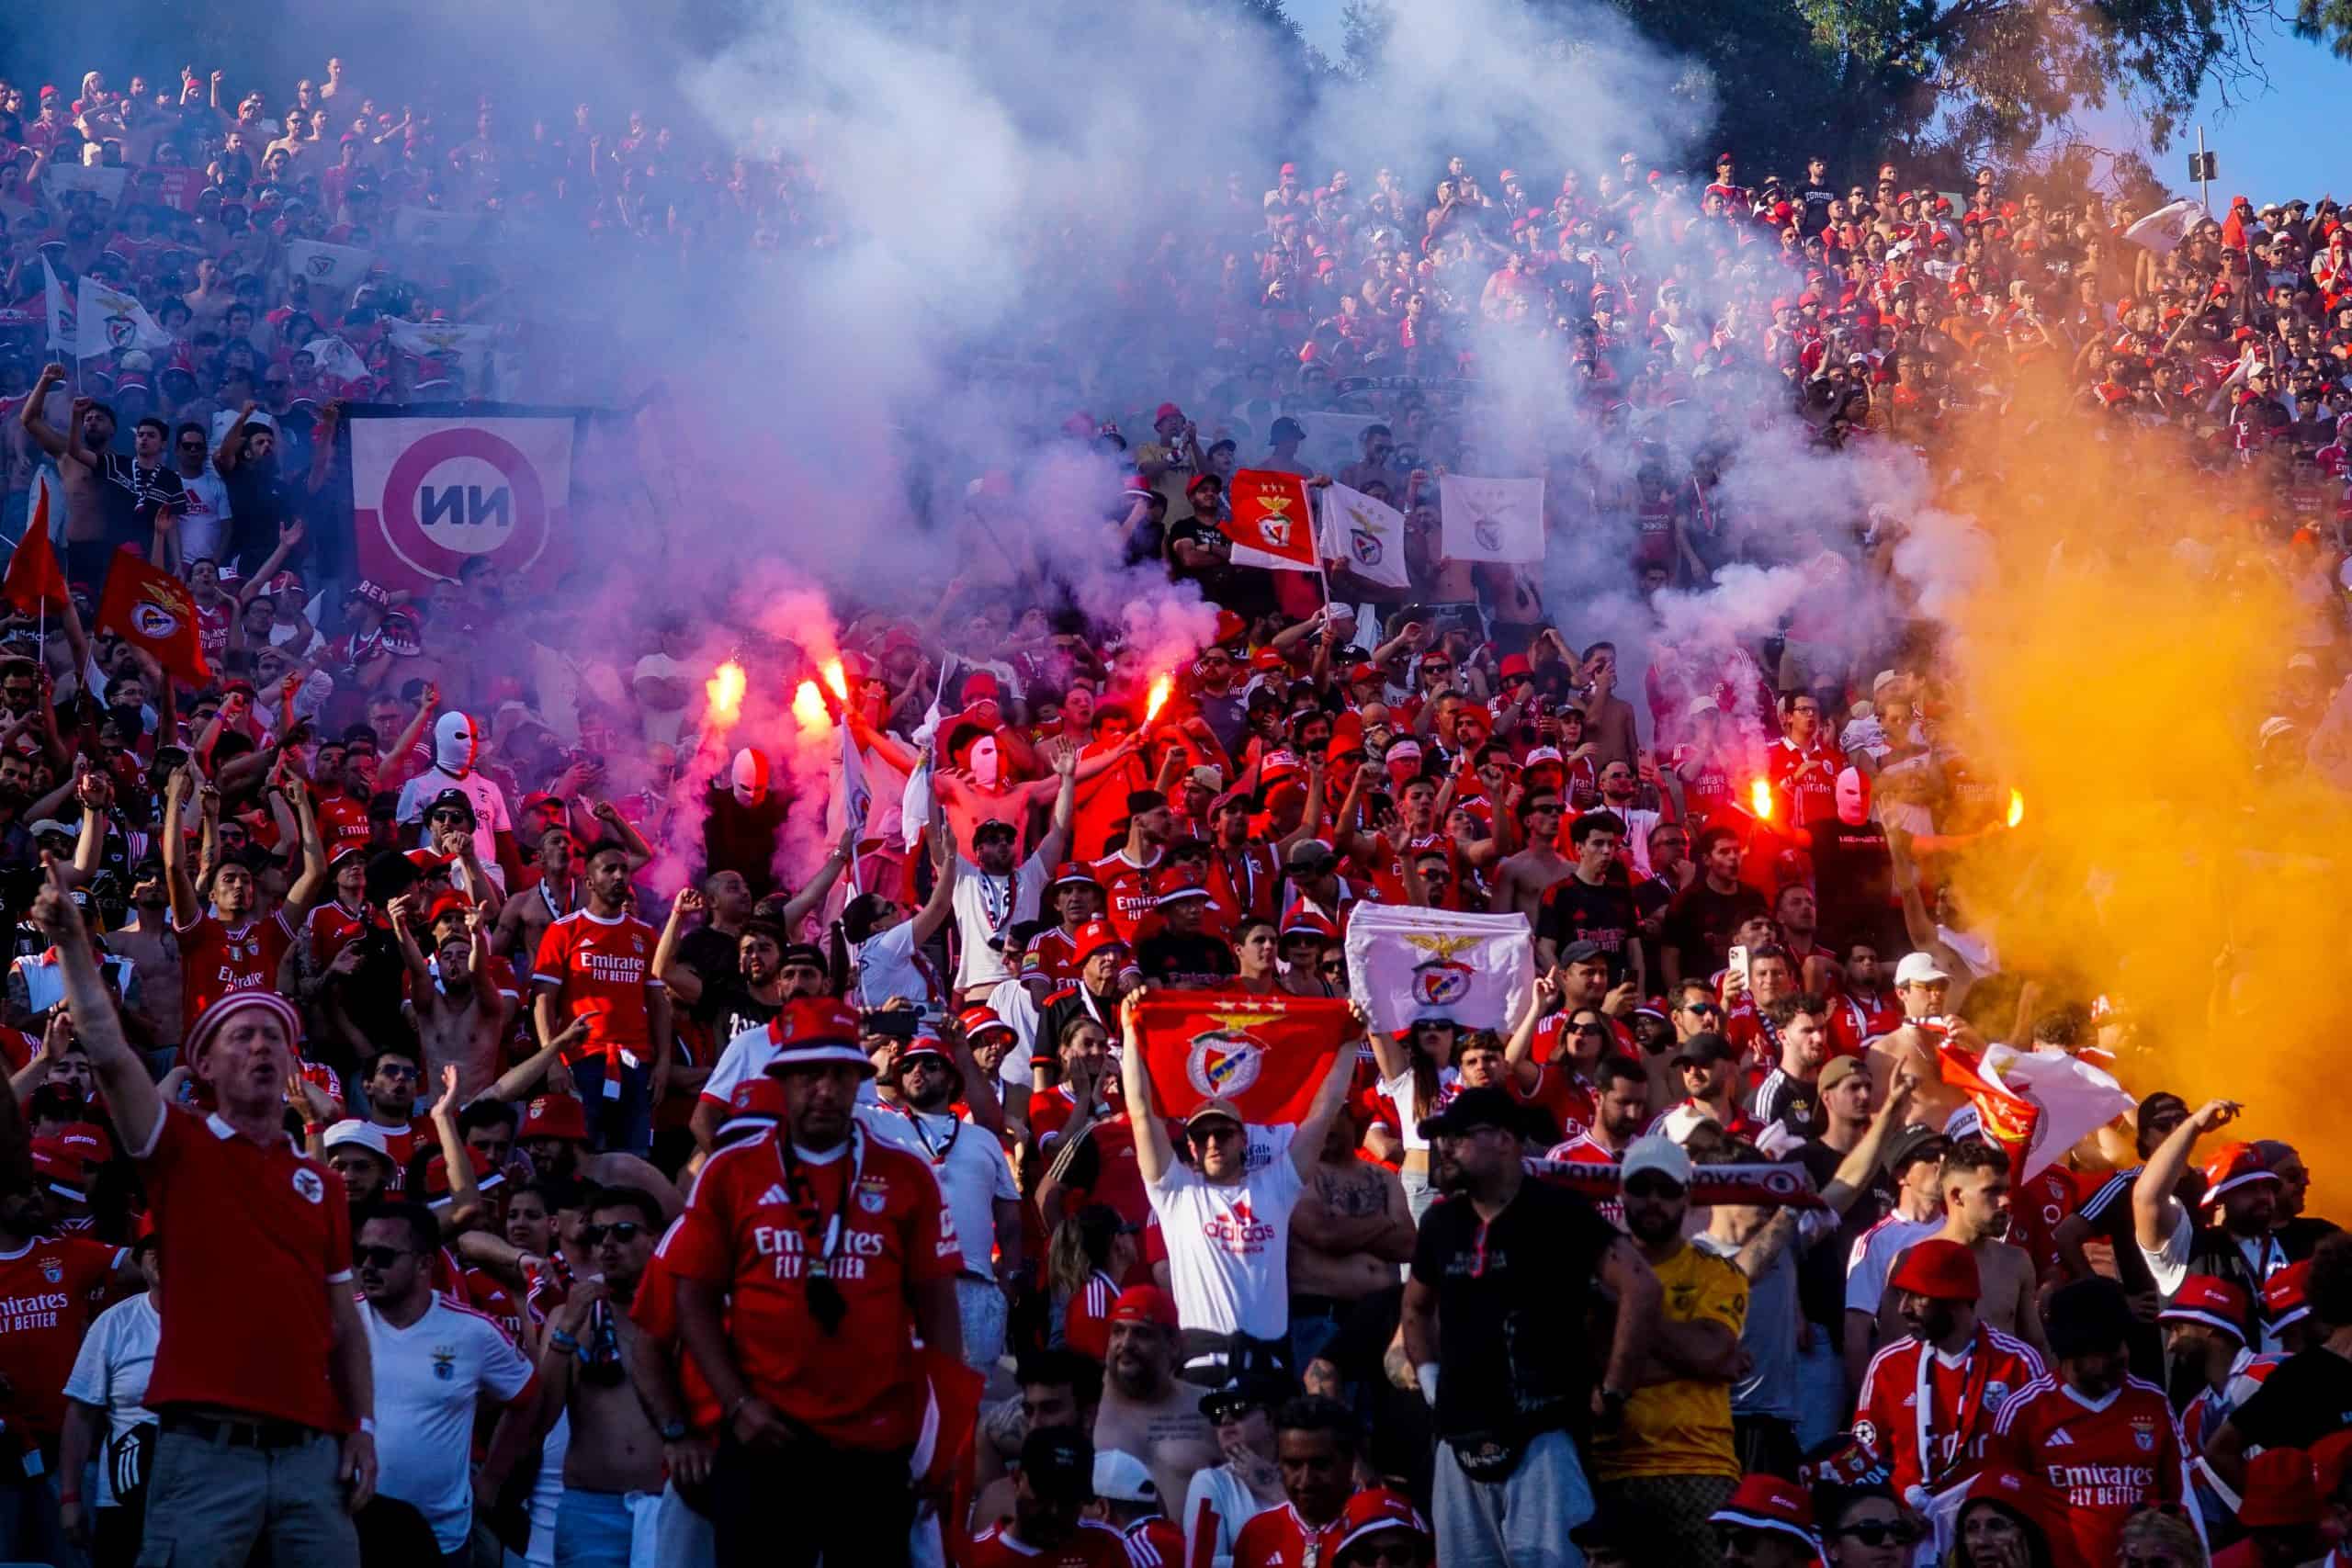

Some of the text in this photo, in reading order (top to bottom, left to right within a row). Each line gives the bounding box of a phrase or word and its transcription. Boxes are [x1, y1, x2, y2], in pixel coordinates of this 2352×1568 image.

[581, 952, 645, 971] Emirates
[593, 968, 640, 984] FLY BETTER
[754, 1226, 885, 1256] Emtes
[775, 1256, 803, 1279] FLY
[15, 1311, 57, 1331] BETTER
[2048, 1462, 2154, 1488] Emirates
[2069, 1486, 2093, 1507] FLY
